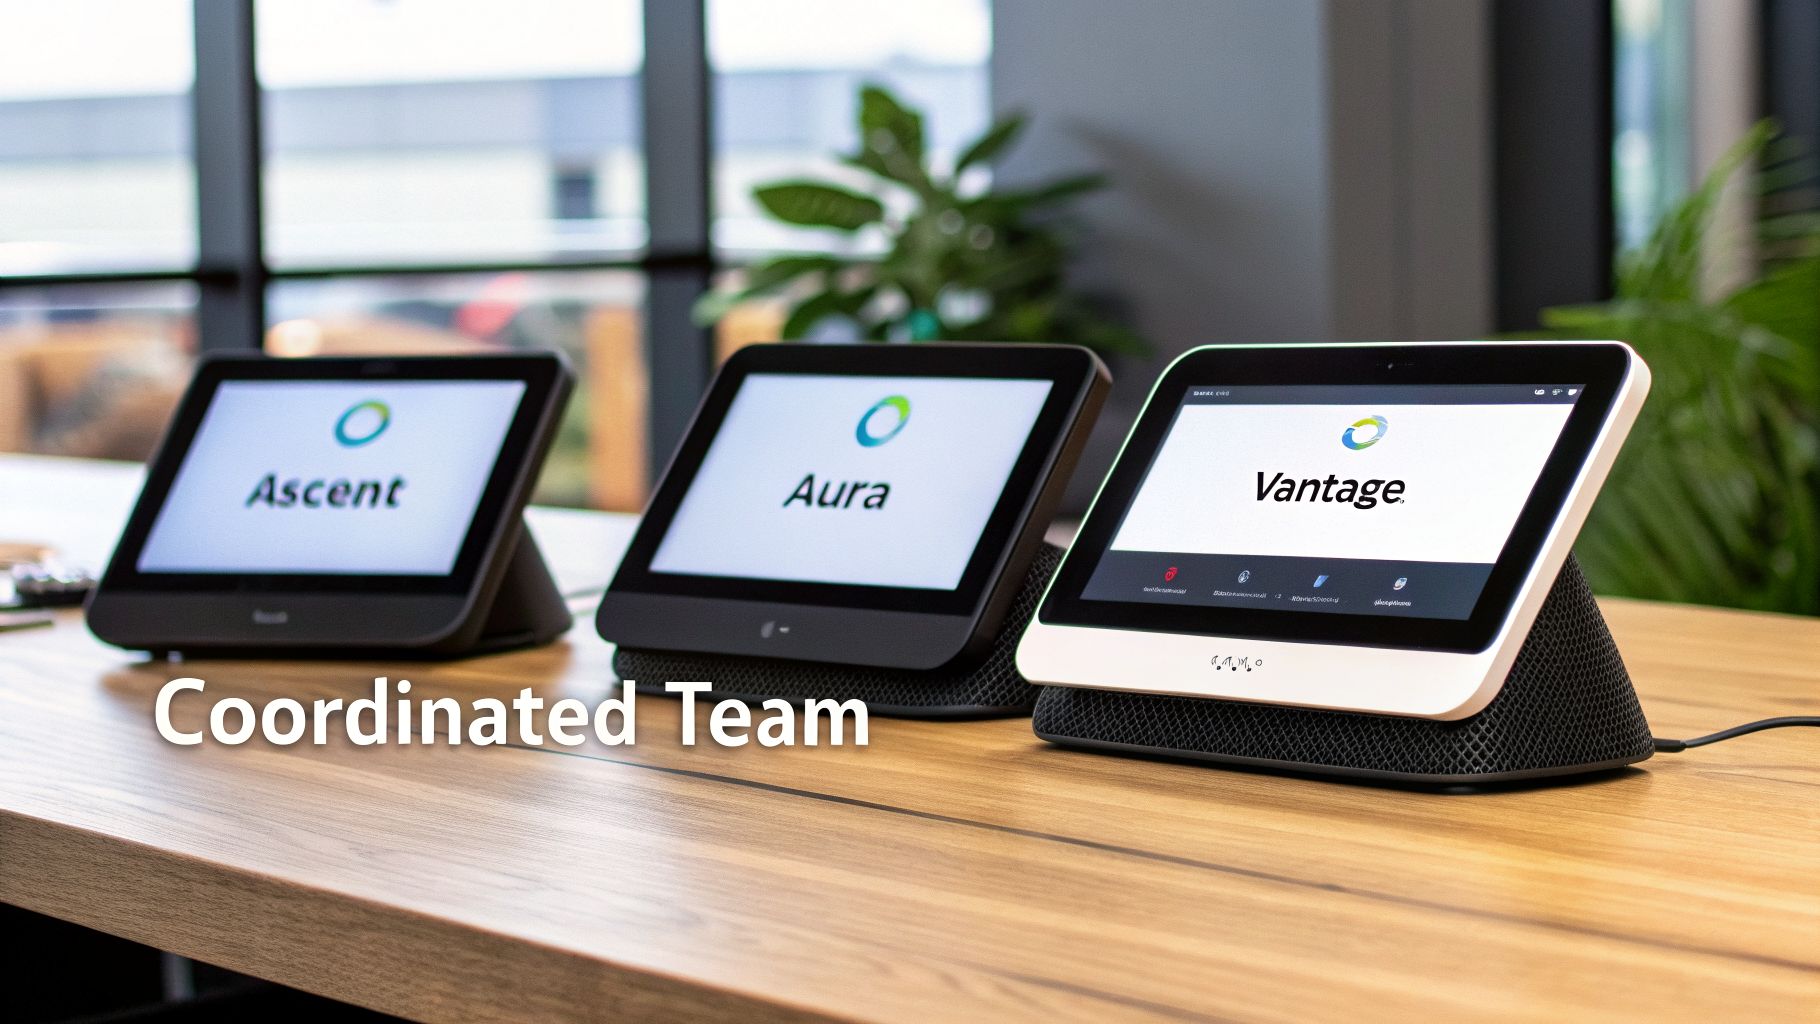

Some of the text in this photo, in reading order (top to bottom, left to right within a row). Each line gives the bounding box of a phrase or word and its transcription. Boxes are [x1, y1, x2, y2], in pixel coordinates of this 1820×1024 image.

[245, 472, 406, 509] Ascent
[782, 473, 891, 510] Aura
[1256, 471, 1406, 510] Vantage
